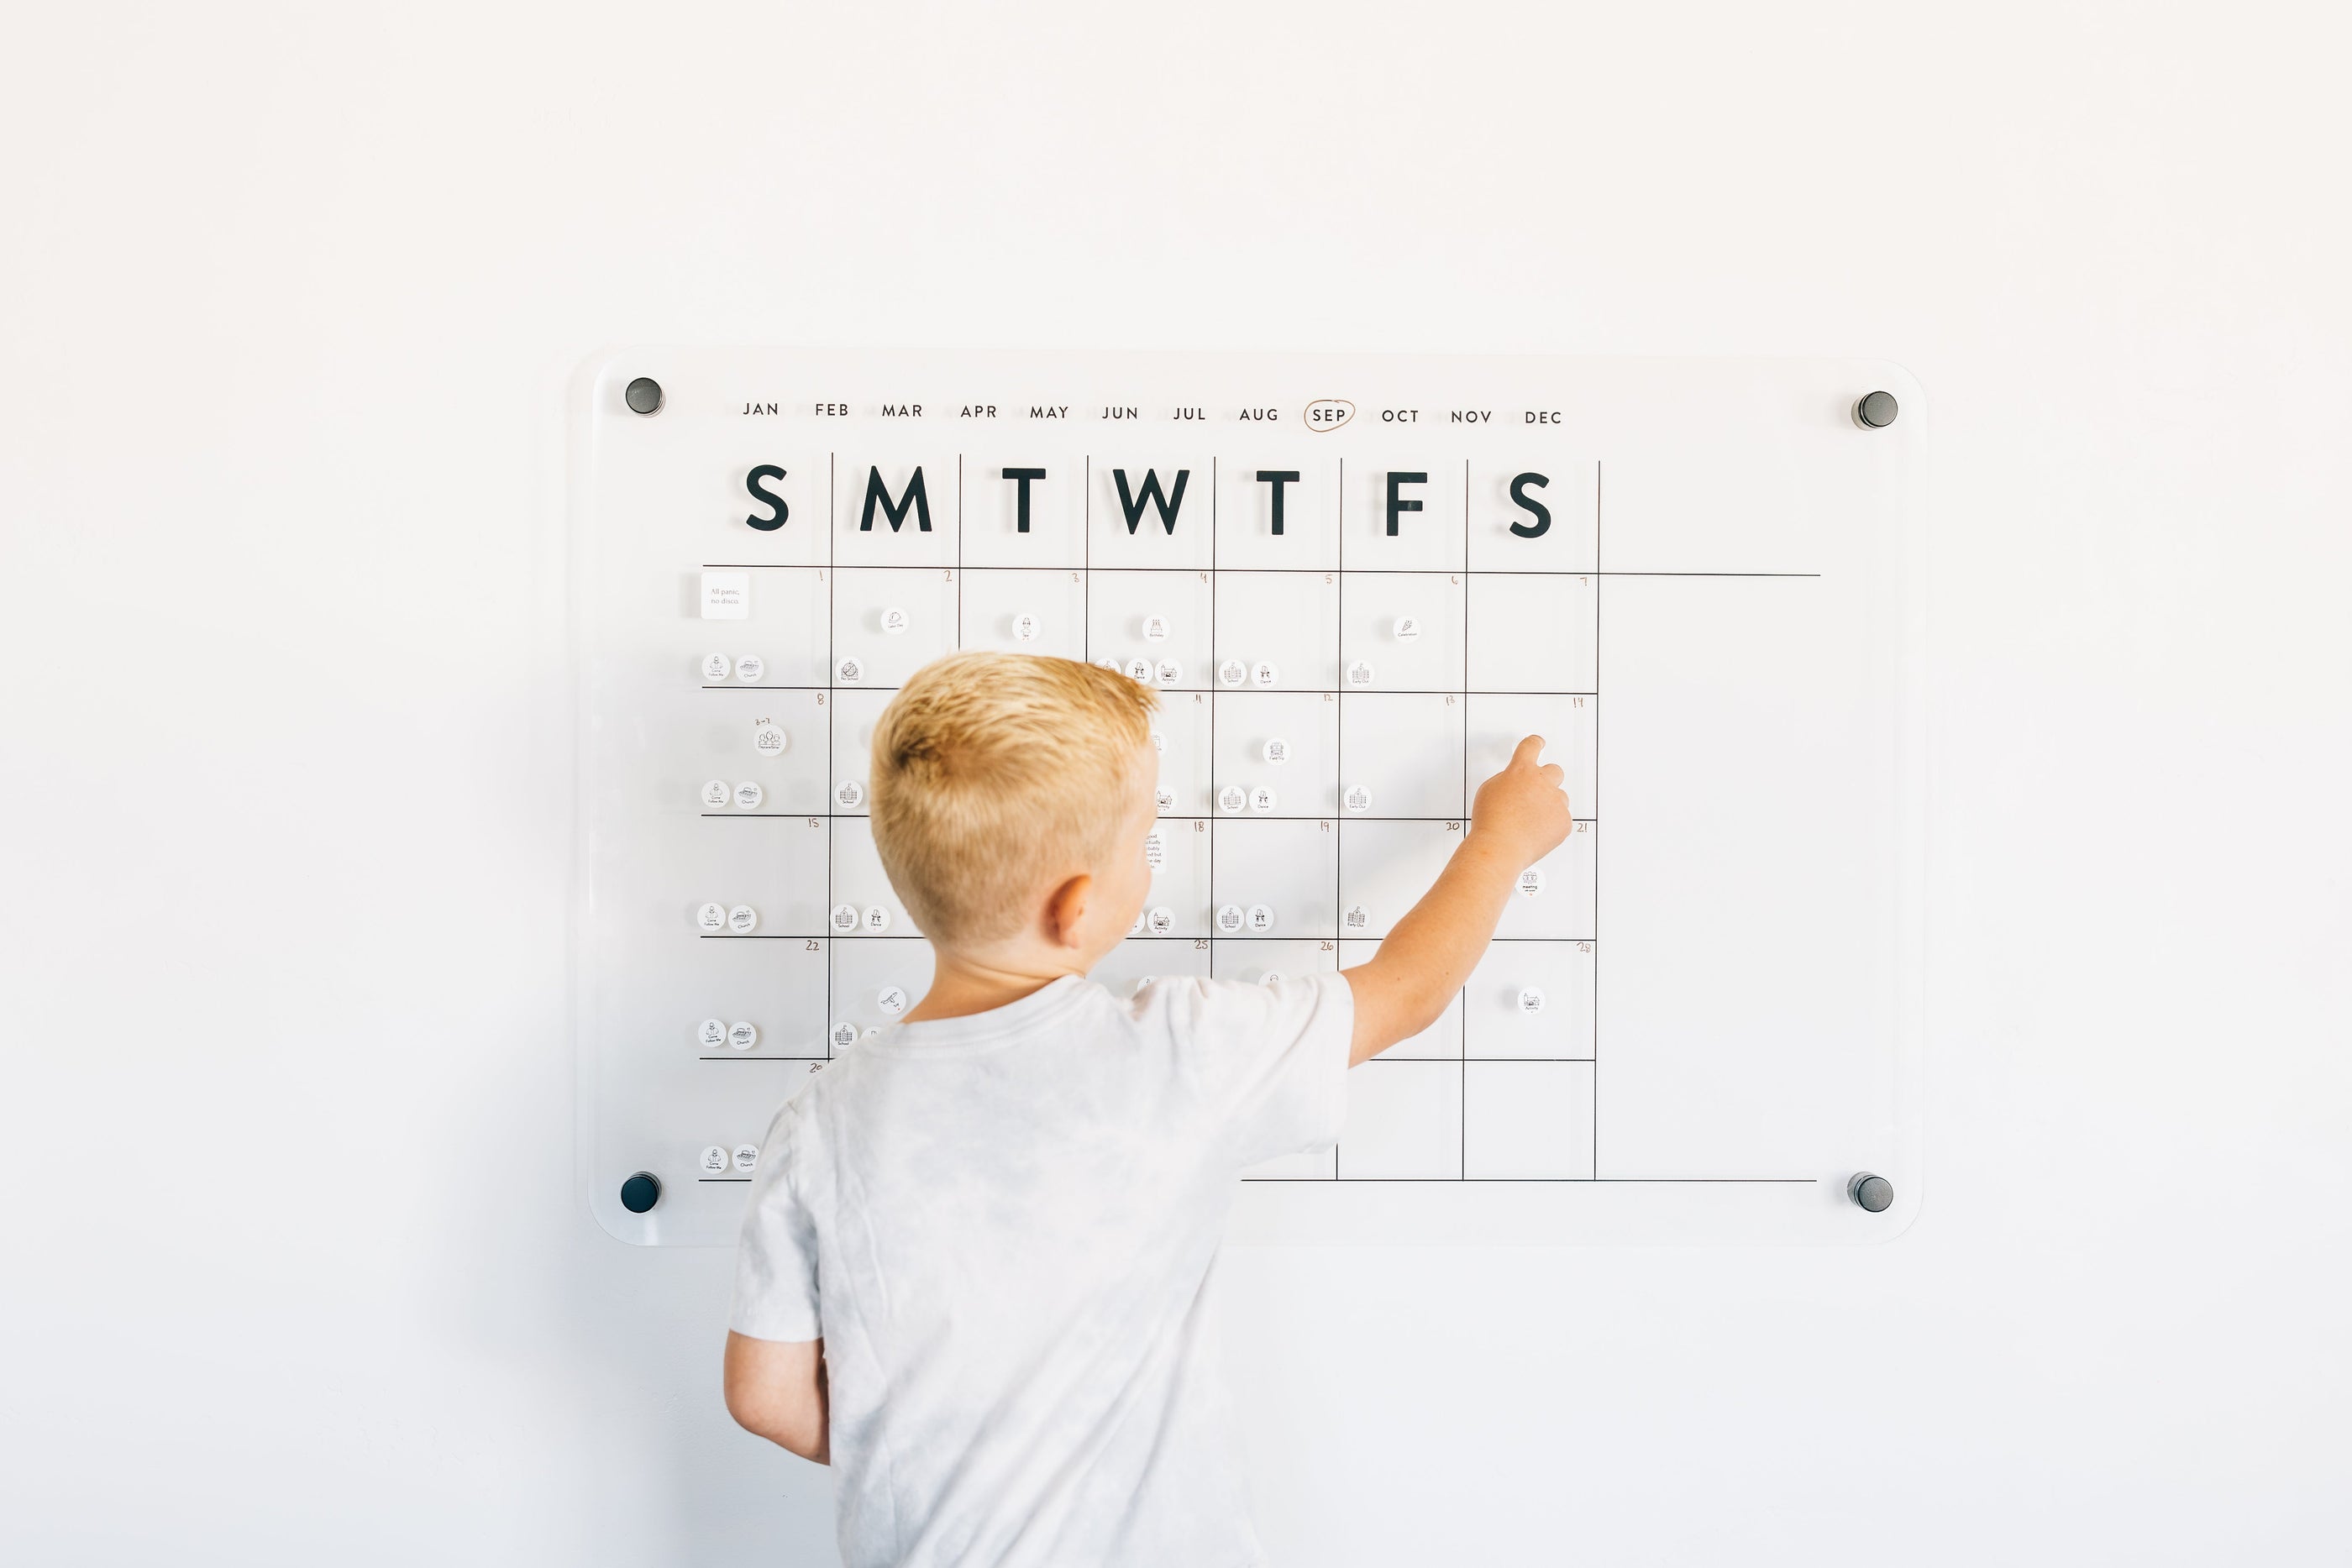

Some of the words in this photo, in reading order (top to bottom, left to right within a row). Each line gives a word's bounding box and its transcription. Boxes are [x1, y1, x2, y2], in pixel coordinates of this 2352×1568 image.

[743, 403, 777, 415] JAN
[816, 404, 848, 416] FEB
[883, 405, 921, 417] MAR
[961, 406, 995, 417] APR
[1031, 406, 1068, 418] MAY
[1103, 407, 1137, 418] JUN
[1173, 408, 1205, 419] JUL
[1240, 409, 1277, 420] AUG
[1314, 410, 1345, 421] SEP
[1383, 411, 1418, 422] OCT
[1452, 412, 1491, 422] NOV
[1526, 412, 1560, 423] DEC
[747, 464, 789, 531] S
[860, 466, 932, 532] M
[1002, 468, 1046, 532] T
[1113, 469, 1189, 535] W
[1257, 471, 1299, 535] T
[1387, 472, 1427, 536] F
[1509, 473, 1551, 538] S
[819, 570, 823, 581] 1
[944, 570, 952, 581] 2
[1073, 573, 1079, 582] 3
[1200, 573, 1206, 583] 4
[1326, 574, 1332, 584] 5
[1452, 574, 1458, 585] 6
[1580, 577, 1587, 585] 7
[817, 694, 824, 705] 8
[1324, 694, 1333, 702] 12
[1446, 695, 1455, 705] 13
[809, 818, 819, 827] 15
[1194, 821, 1204, 831] 18
[1321, 821, 1329, 832] 19
[1446, 822, 1459, 831] 20
[1577, 823, 1587, 832] 21
[806, 940, 819, 951] 22
[1194, 940, 1209, 949] 25
[1321, 941, 1333, 951] 26
[1577, 942, 1590, 952] 28
